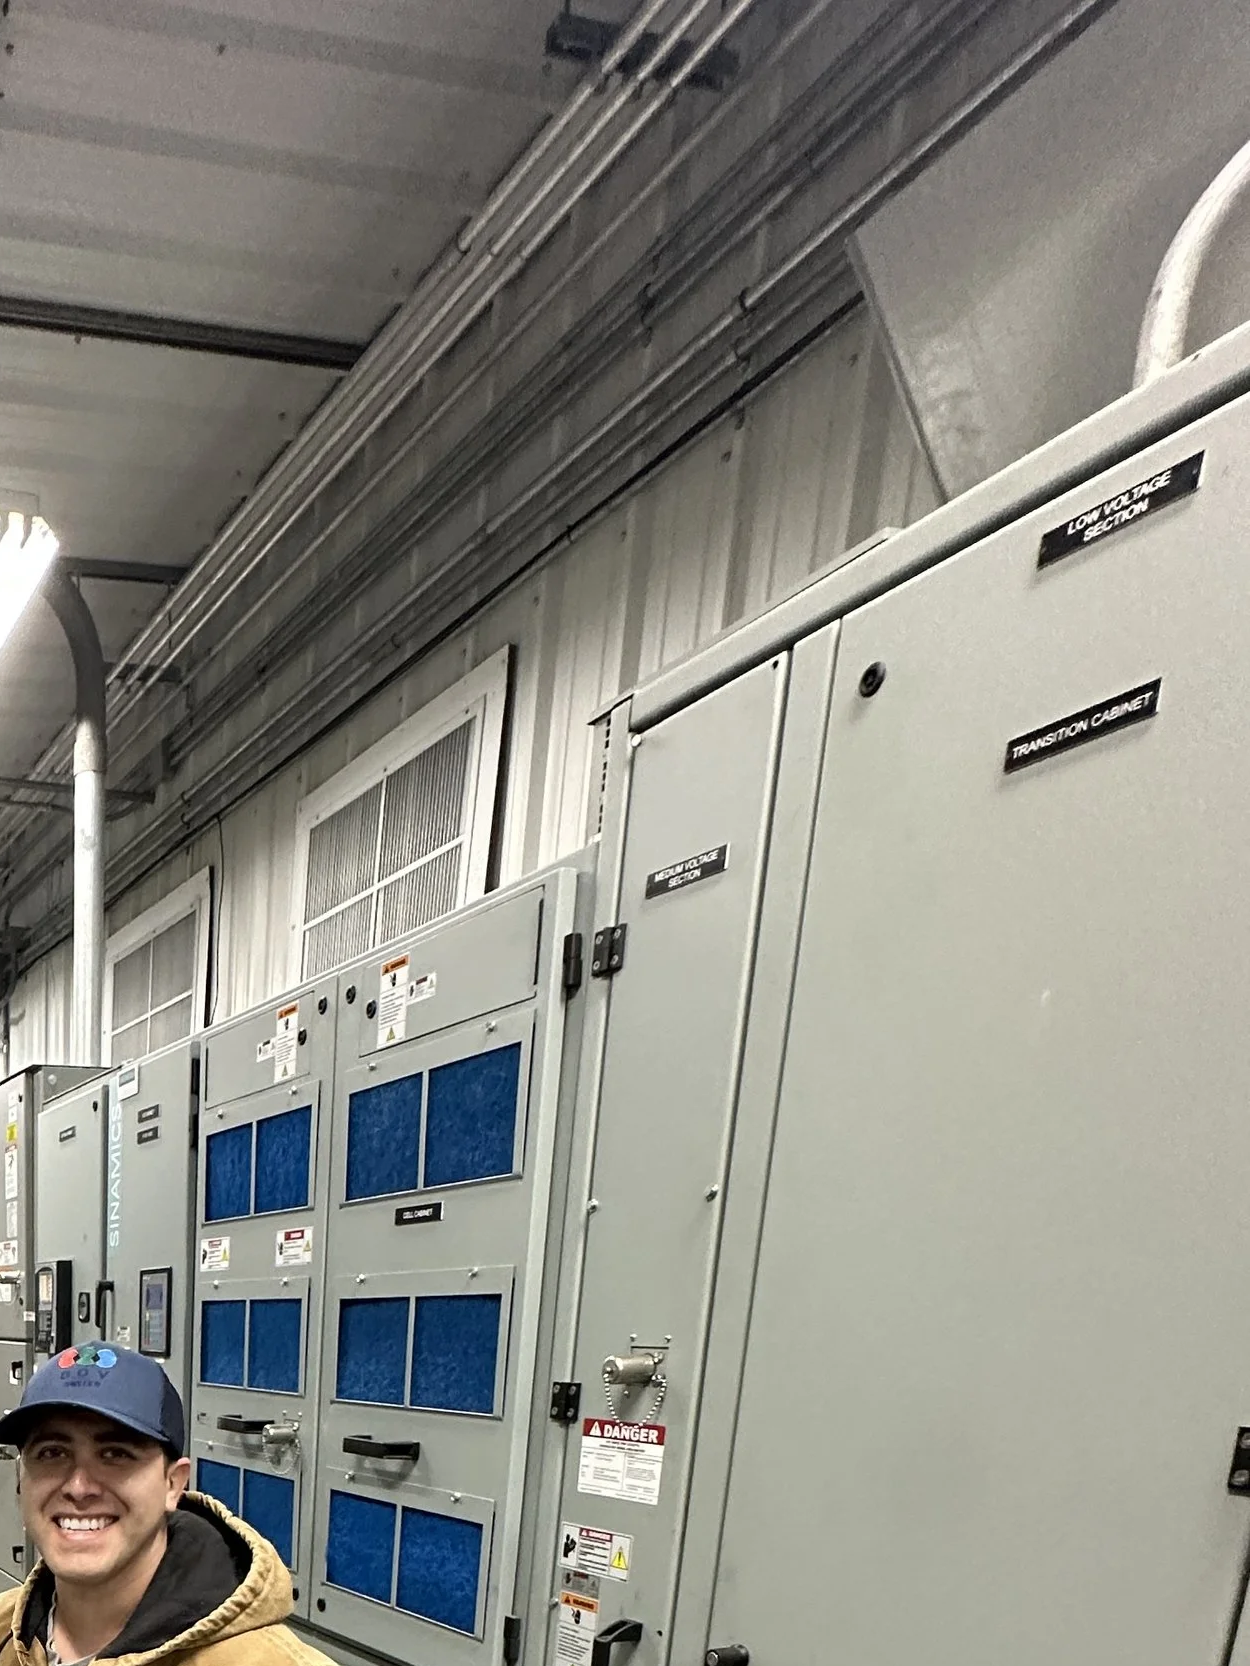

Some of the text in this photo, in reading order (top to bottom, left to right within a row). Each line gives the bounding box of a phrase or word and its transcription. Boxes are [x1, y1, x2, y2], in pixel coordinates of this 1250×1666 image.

[1067, 469, 1172, 535] LOW VOLTAGE
[1083, 498, 1149, 541] SECTION
[1012, 692, 1153, 759] TRANSITION CABINET
[654, 849, 719, 882] MEDIUM VOLTAGE
[668, 868, 701, 887] SECTION
[109, 1102, 123, 1247] SINAMICS
[603, 1423, 659, 1443] DANGER
